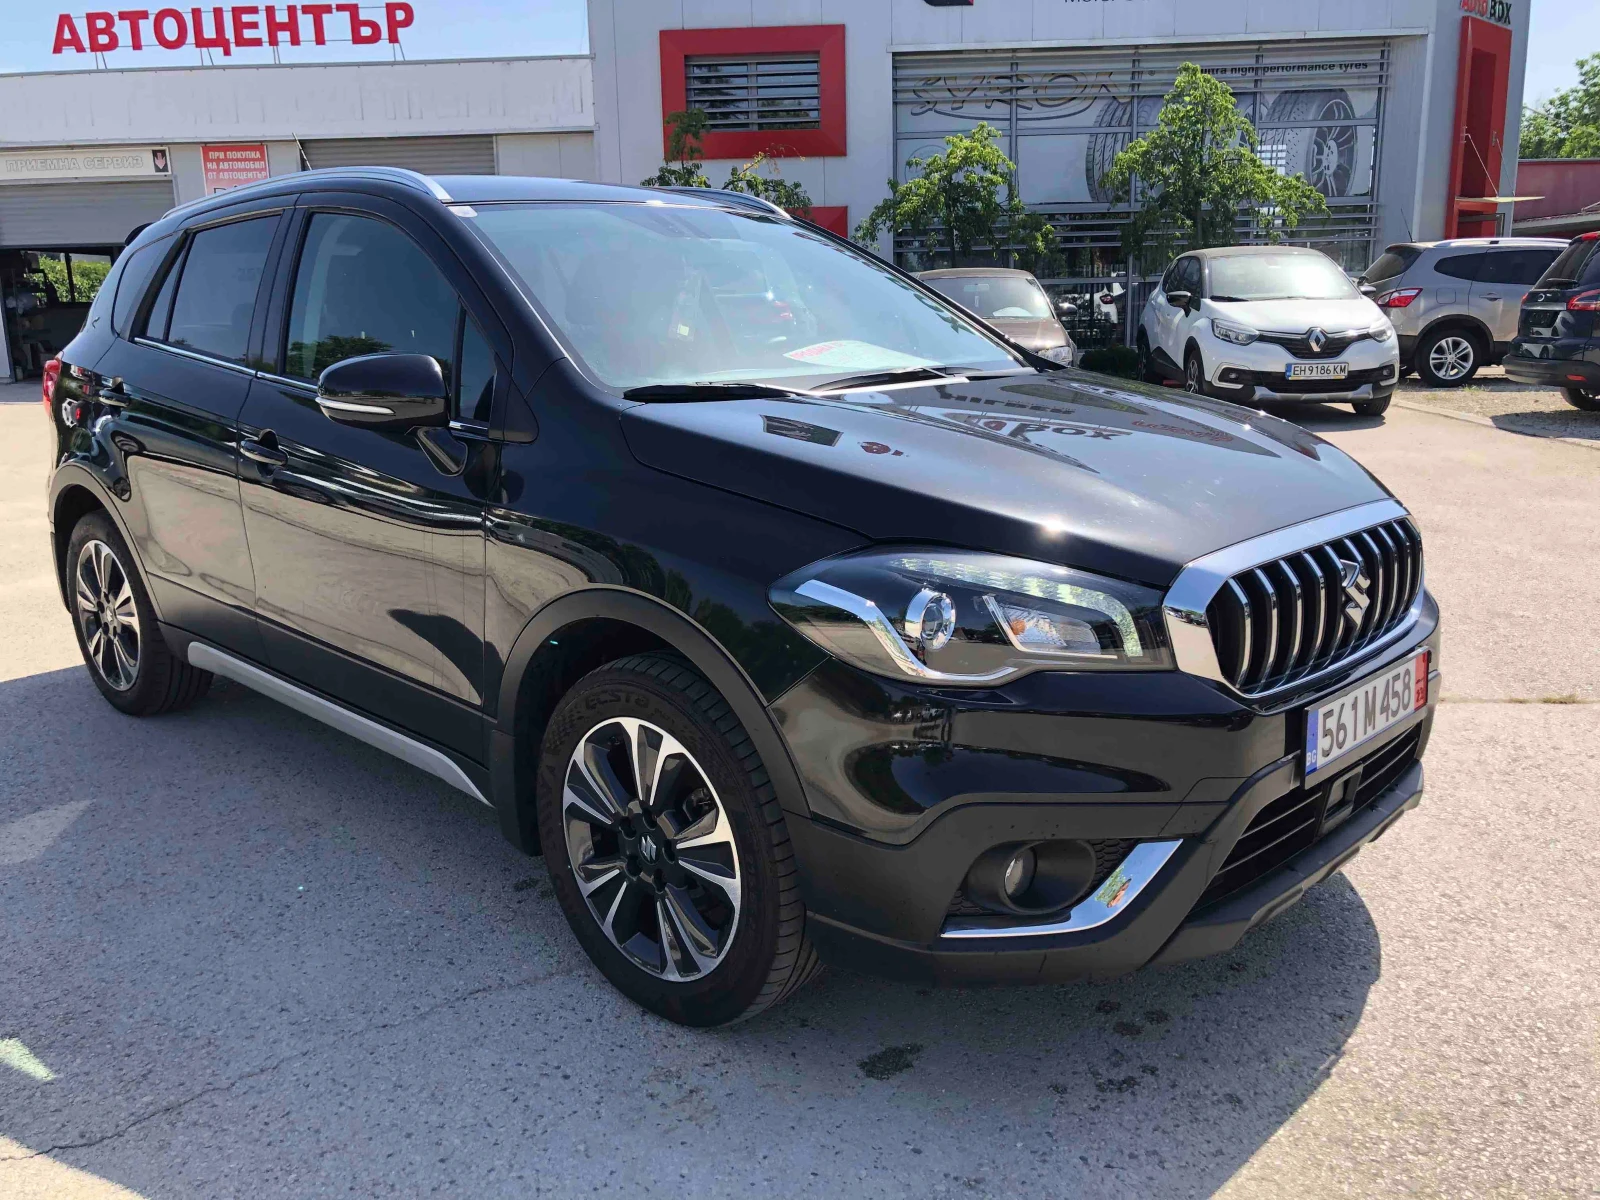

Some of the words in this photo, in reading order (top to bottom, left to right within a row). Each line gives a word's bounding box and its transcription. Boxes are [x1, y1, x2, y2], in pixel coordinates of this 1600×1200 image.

[1490, 0, 1512, 24] BOX
[52, 2, 414, 57] АВТОЦЕНТЪР
[208, 151, 225, 159] ПРИ
[226, 150, 261, 159] ПОКУПКА
[6, 158, 81, 172] ПРИЕМНА
[83, 155, 144, 170] СЕРВИЗ
[207, 161, 218, 170] НА
[219, 161, 265, 170] АВТОМОБИЛ
[207, 171, 217, 179] ОТ
[220, 171, 267, 180] АВТОЦЕНТЪР
[1305, 751, 1317, 767] BG
